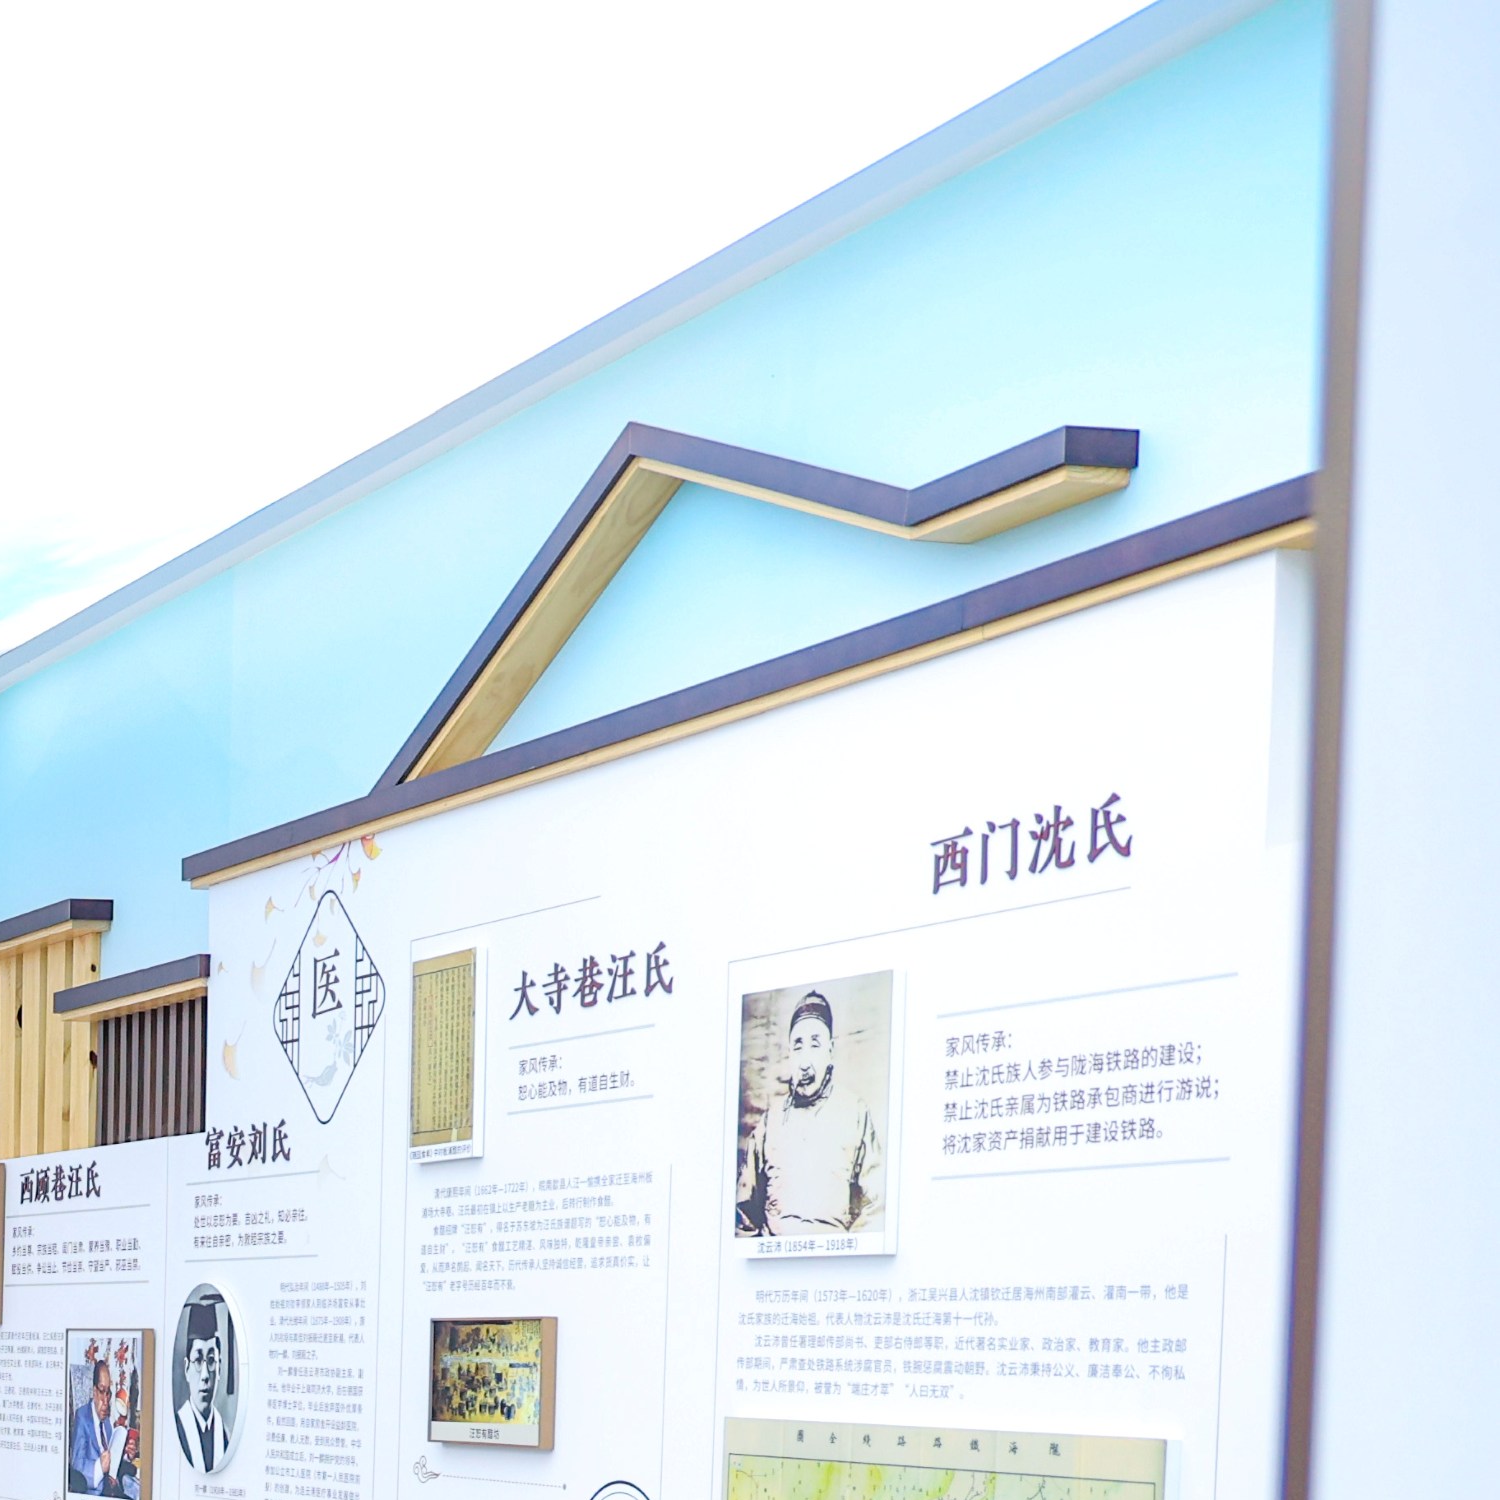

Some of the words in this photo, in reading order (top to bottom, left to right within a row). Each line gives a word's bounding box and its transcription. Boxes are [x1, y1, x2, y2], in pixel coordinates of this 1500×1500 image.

[929, 792, 1134, 895] 西门沈氏
[309, 946, 342, 1022] 医
[508, 940, 675, 1022] 大寺巷汪氏
[518, 1055, 562, 1076] 家风传承：
[944, 1042, 1202, 1090] 禁止沈氏族人参与陇海铁路的建设；
[945, 1031, 1012, 1058] 家风传承：
[518, 1070, 635, 1100] 恕心能及物，有道自生财。
[944, 1076, 1219, 1122] 禁止沈氏亲属为铁路承包商进行游说；
[203, 1118, 292, 1173] 富安刘氏
[943, 1117, 1163, 1155] 将沈家资产捐献用于建设铁路。
[18, 1159, 102, 1206] 西顾巷汪氏
